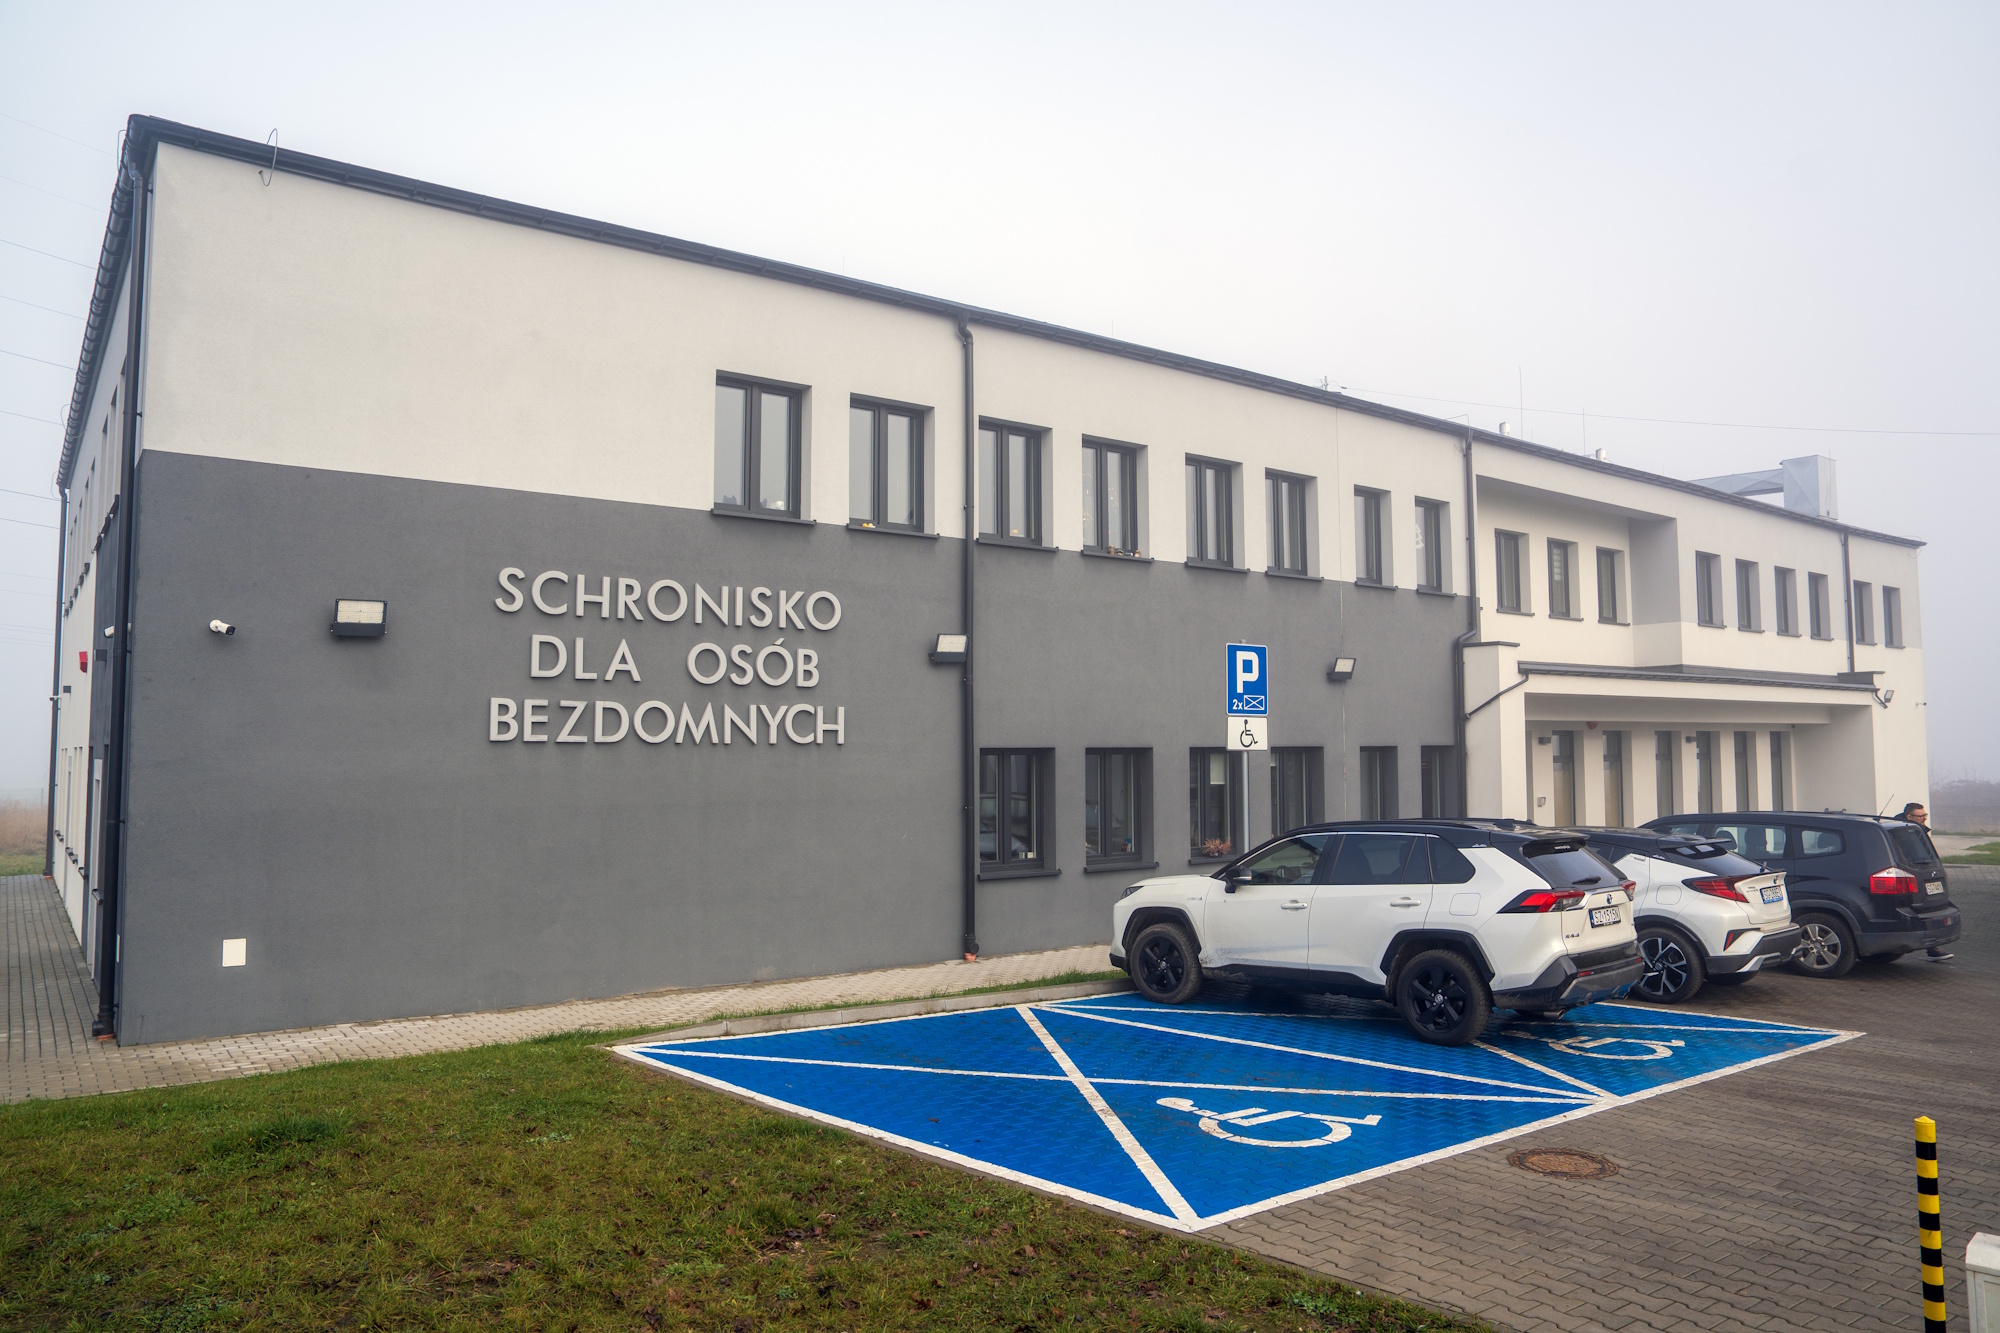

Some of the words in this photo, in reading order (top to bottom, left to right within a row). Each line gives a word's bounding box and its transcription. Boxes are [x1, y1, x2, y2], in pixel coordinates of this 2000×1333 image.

[495, 567, 842, 631] SCHRONISKO
[530, 634, 641, 682] DLA
[687, 637, 820, 688] OSÓB
[1236, 650, 1260, 694] P
[489, 697, 845, 745] BEZDOMNYCH
